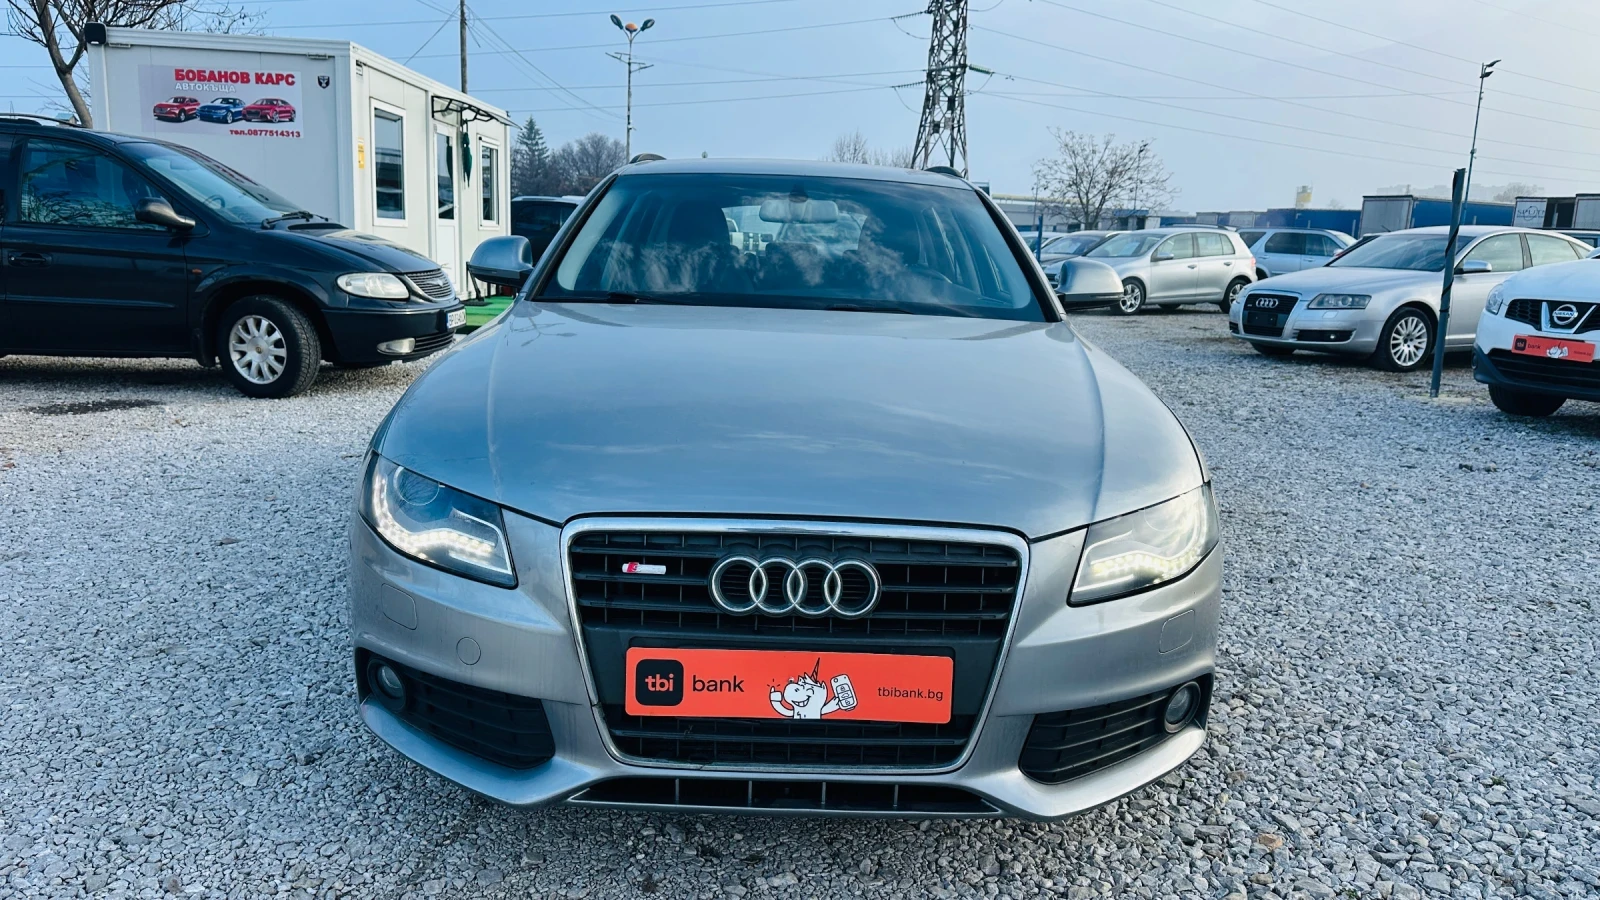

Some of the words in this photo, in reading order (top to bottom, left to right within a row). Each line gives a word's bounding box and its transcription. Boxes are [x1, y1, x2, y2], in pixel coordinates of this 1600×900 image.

[174, 69, 250, 84] БОБАНОВ
[255, 72, 296, 86] КАРС
[175, 82, 236, 93] АВТОКЪЩА
[229, 129, 301, 138] тел.0877514313
[645, 673, 674, 692] tbi
[692, 675, 745, 693] bank
[877, 687, 944, 702] tbibank.bg
